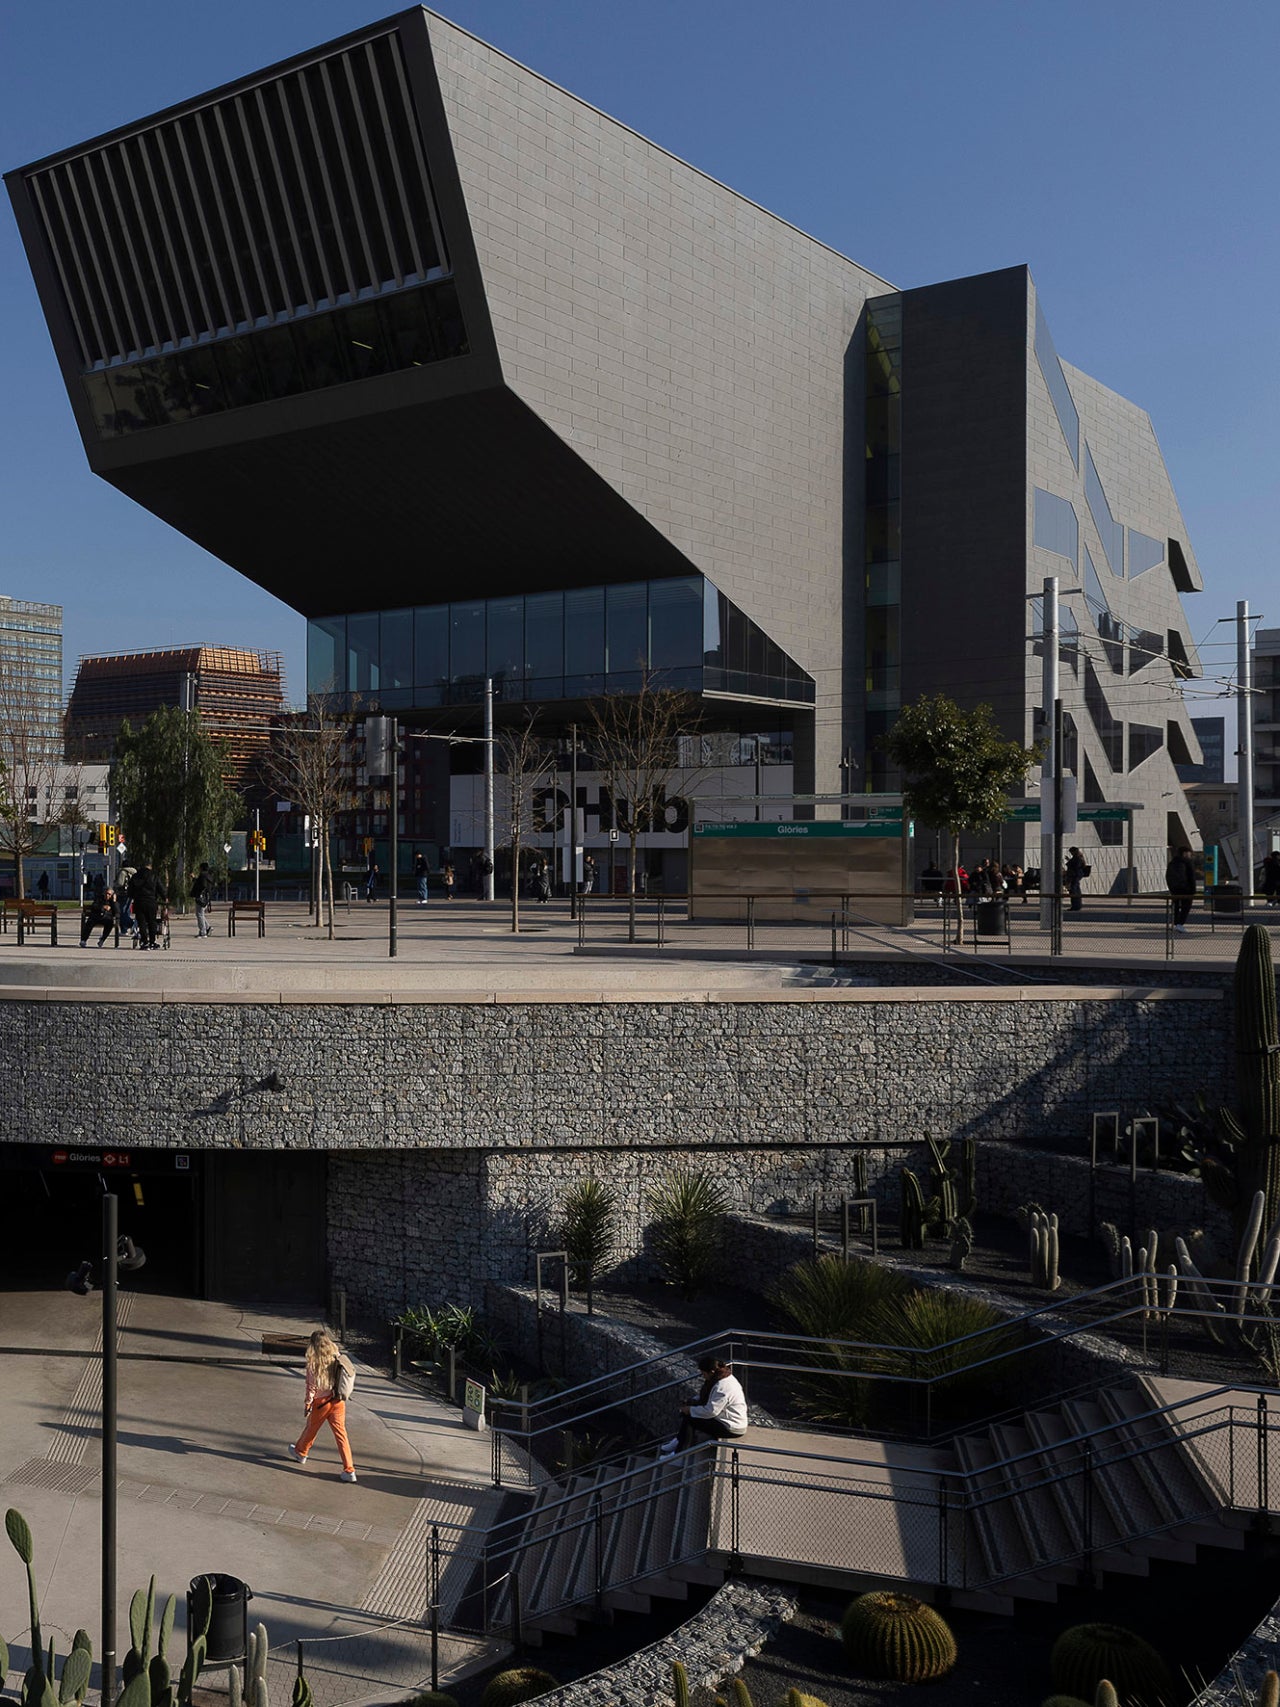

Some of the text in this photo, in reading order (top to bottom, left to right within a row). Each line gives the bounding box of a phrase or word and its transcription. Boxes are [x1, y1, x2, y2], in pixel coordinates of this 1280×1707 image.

[777, 825, 809, 834] Glòries
[69, 1152, 101, 1162] Glòries
[118, 1155, 129, 1164] L1
